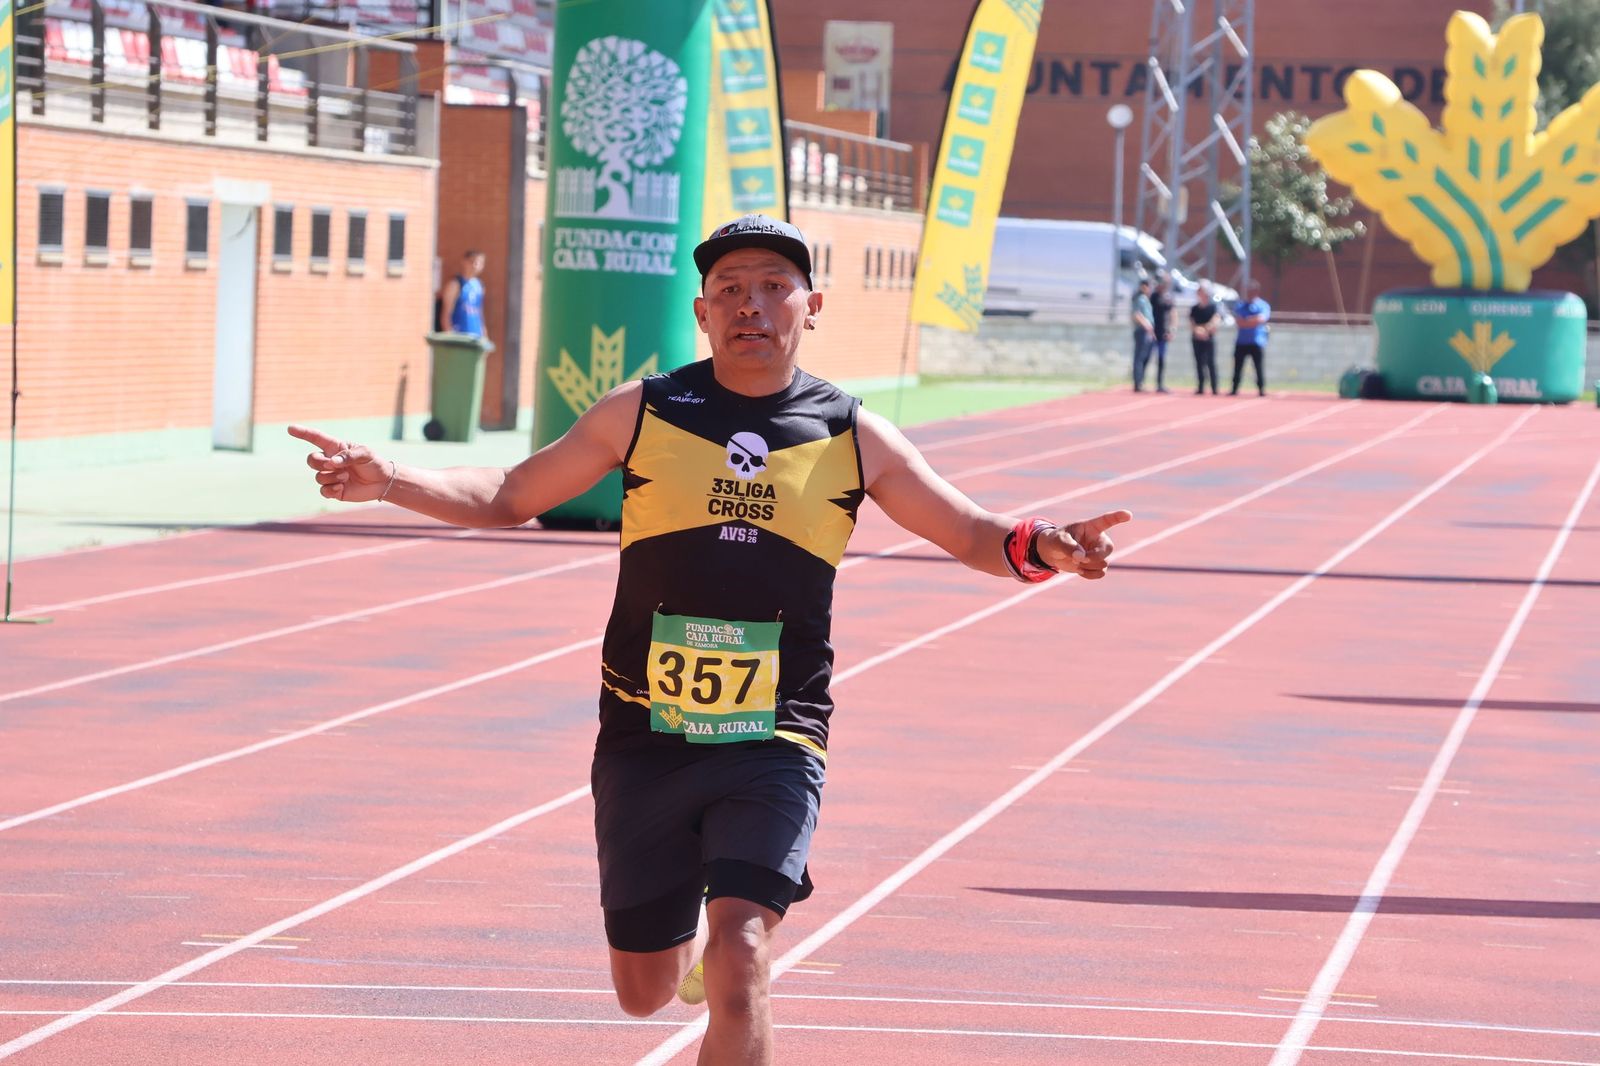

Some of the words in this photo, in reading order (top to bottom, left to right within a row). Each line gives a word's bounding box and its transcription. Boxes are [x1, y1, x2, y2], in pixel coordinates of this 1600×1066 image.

[554, 227, 678, 252] FUNDACION
[552, 248, 599, 270] CAJA
[602, 250, 677, 276] RURAL
[1416, 375, 1467, 395] CAJA
[708, 498, 775, 521] CROSS
[719, 525, 747, 542] AVS
[747, 535, 757, 544] 26
[685, 631, 709, 642] CAJA
[711, 634, 745, 645] RURAL
[694, 641, 719, 649] ZAMORA
[657, 650, 761, 705] 357
[682, 720, 715, 735] CAJA
[717, 720, 768, 735] RURAL
